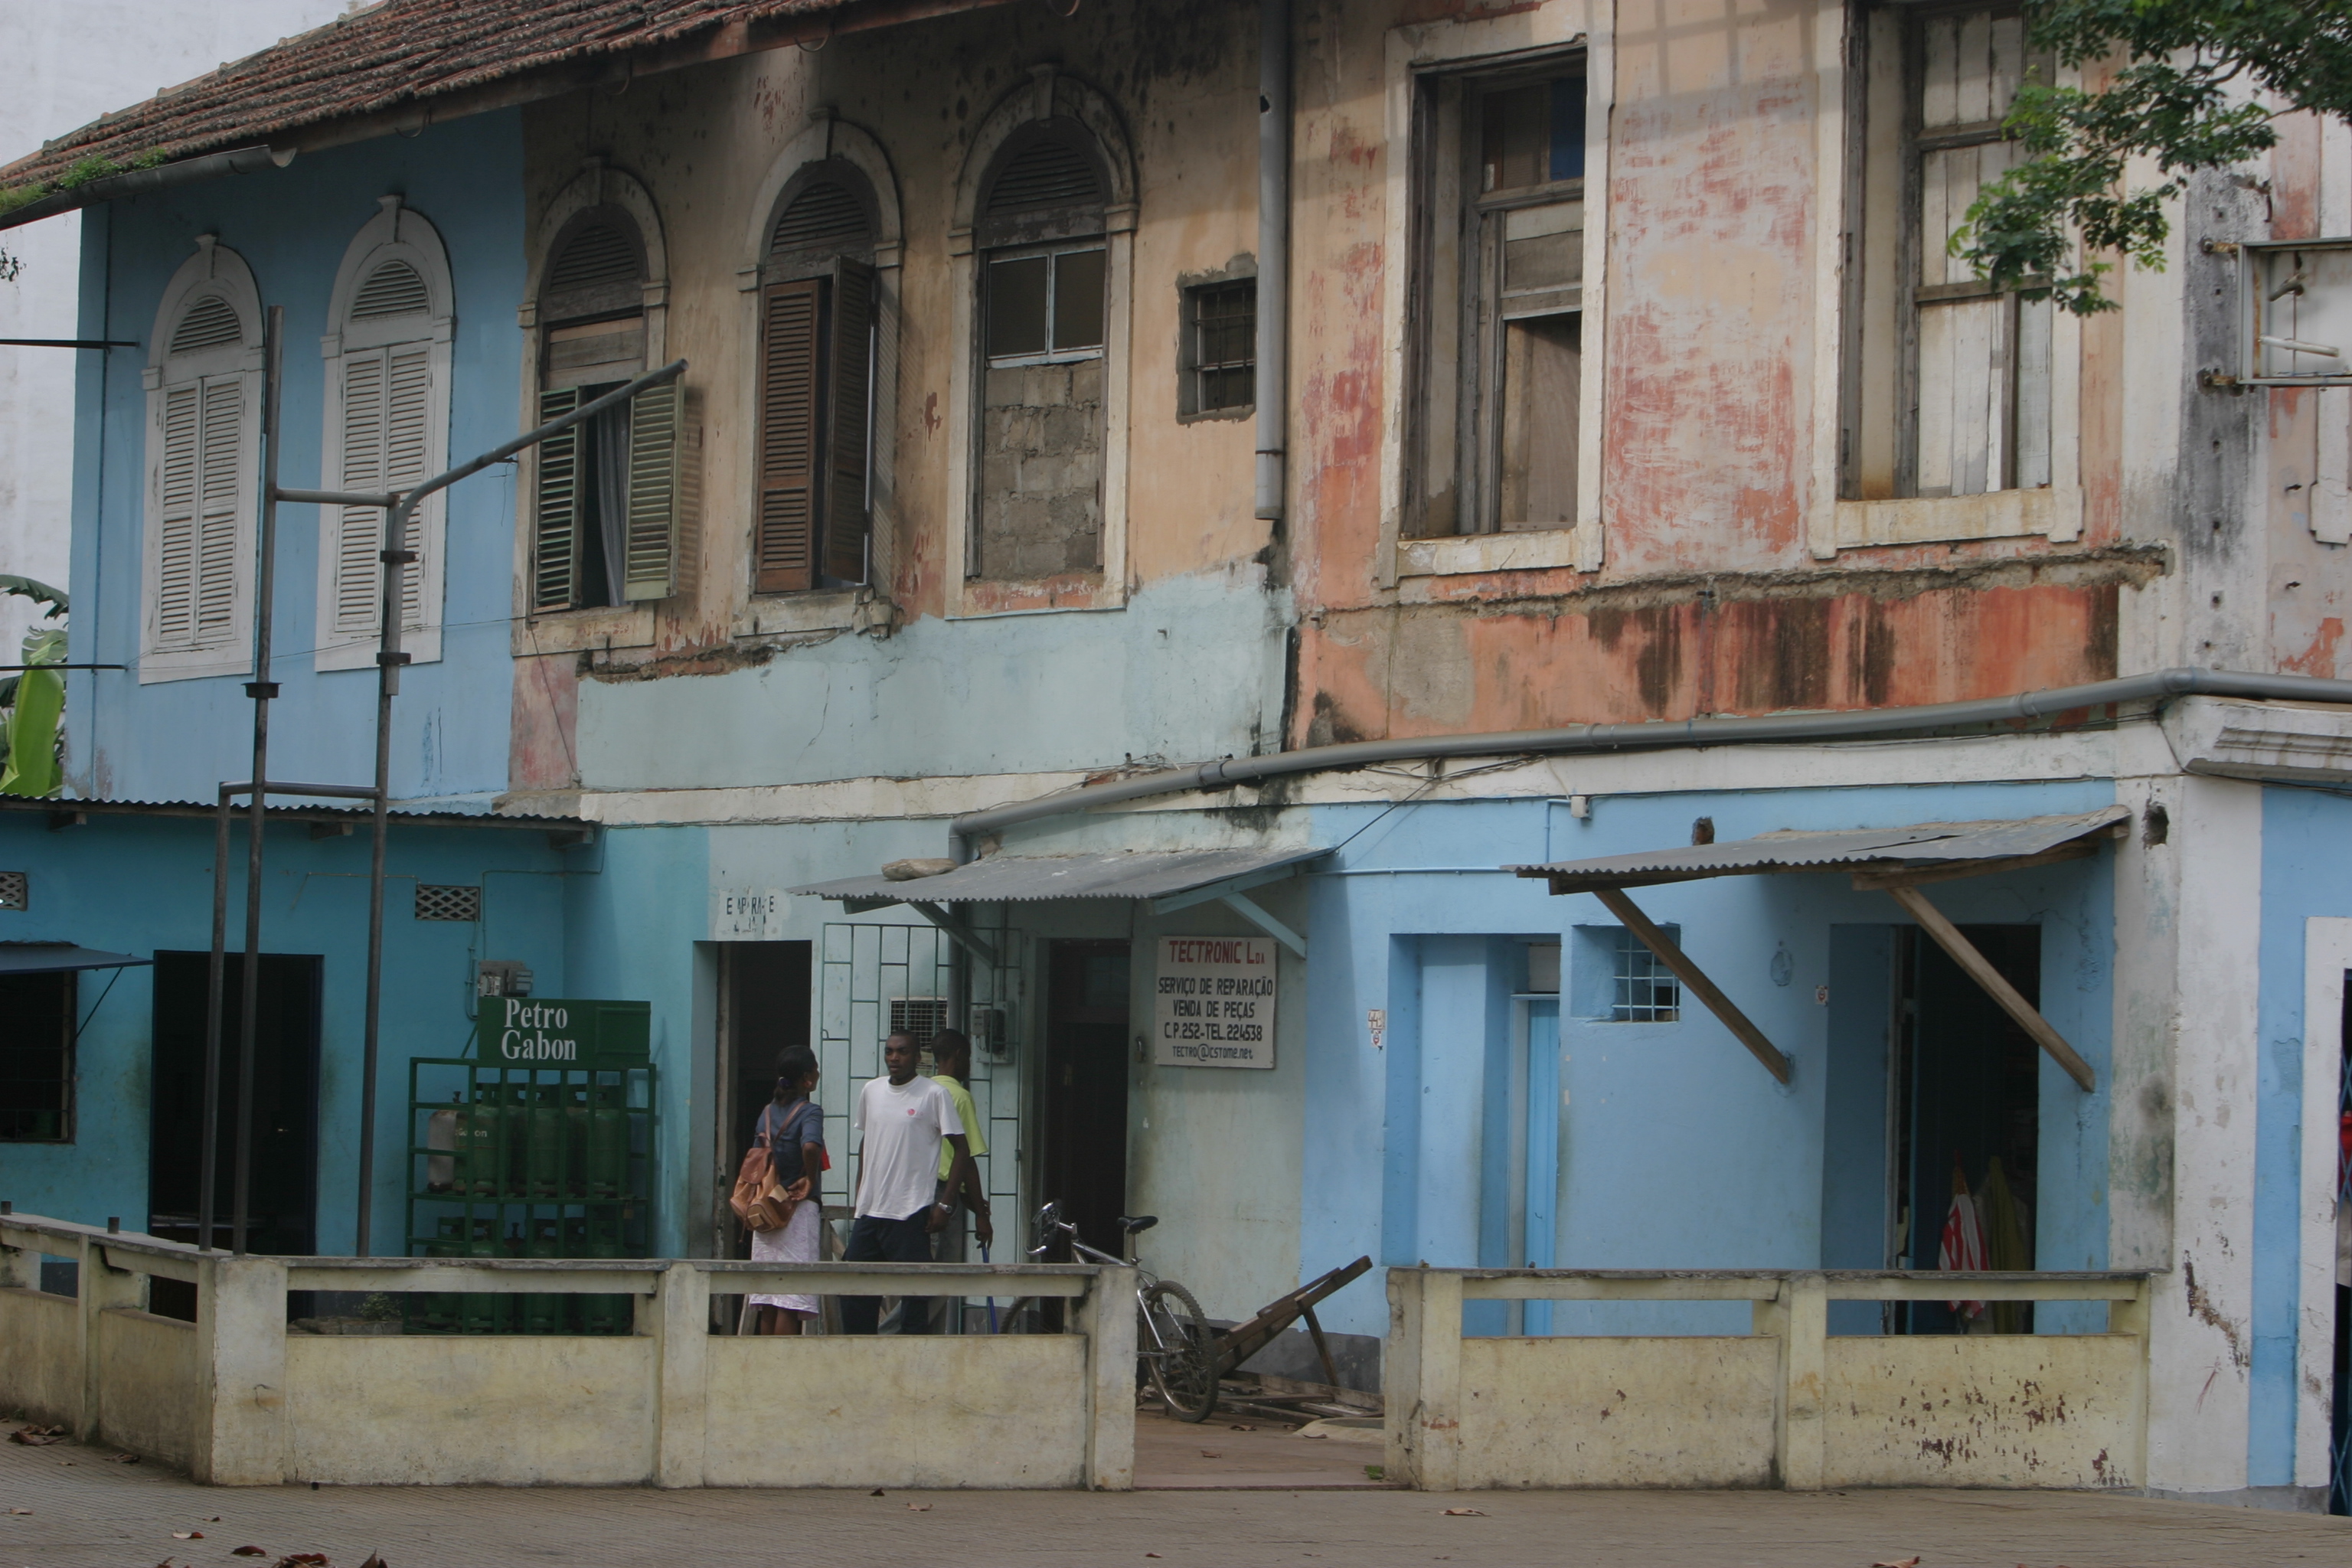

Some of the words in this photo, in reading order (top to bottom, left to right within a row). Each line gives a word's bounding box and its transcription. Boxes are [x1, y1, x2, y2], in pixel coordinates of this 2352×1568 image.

[1169, 940, 1242, 964] TECTRONIC
[1158, 977, 1195, 997] SERVIÇO
[1200, 978, 1212, 995] DE
[1217, 976, 1272, 998] REPARAÇÃO
[504, 998, 568, 1029] Petro
[1173, 999, 1201, 1017] VENDA
[1206, 1001, 1219, 1018] DE
[1224, 1001, 1255, 1021] PEÇAS
[501, 1030, 577, 1060] Gabon
